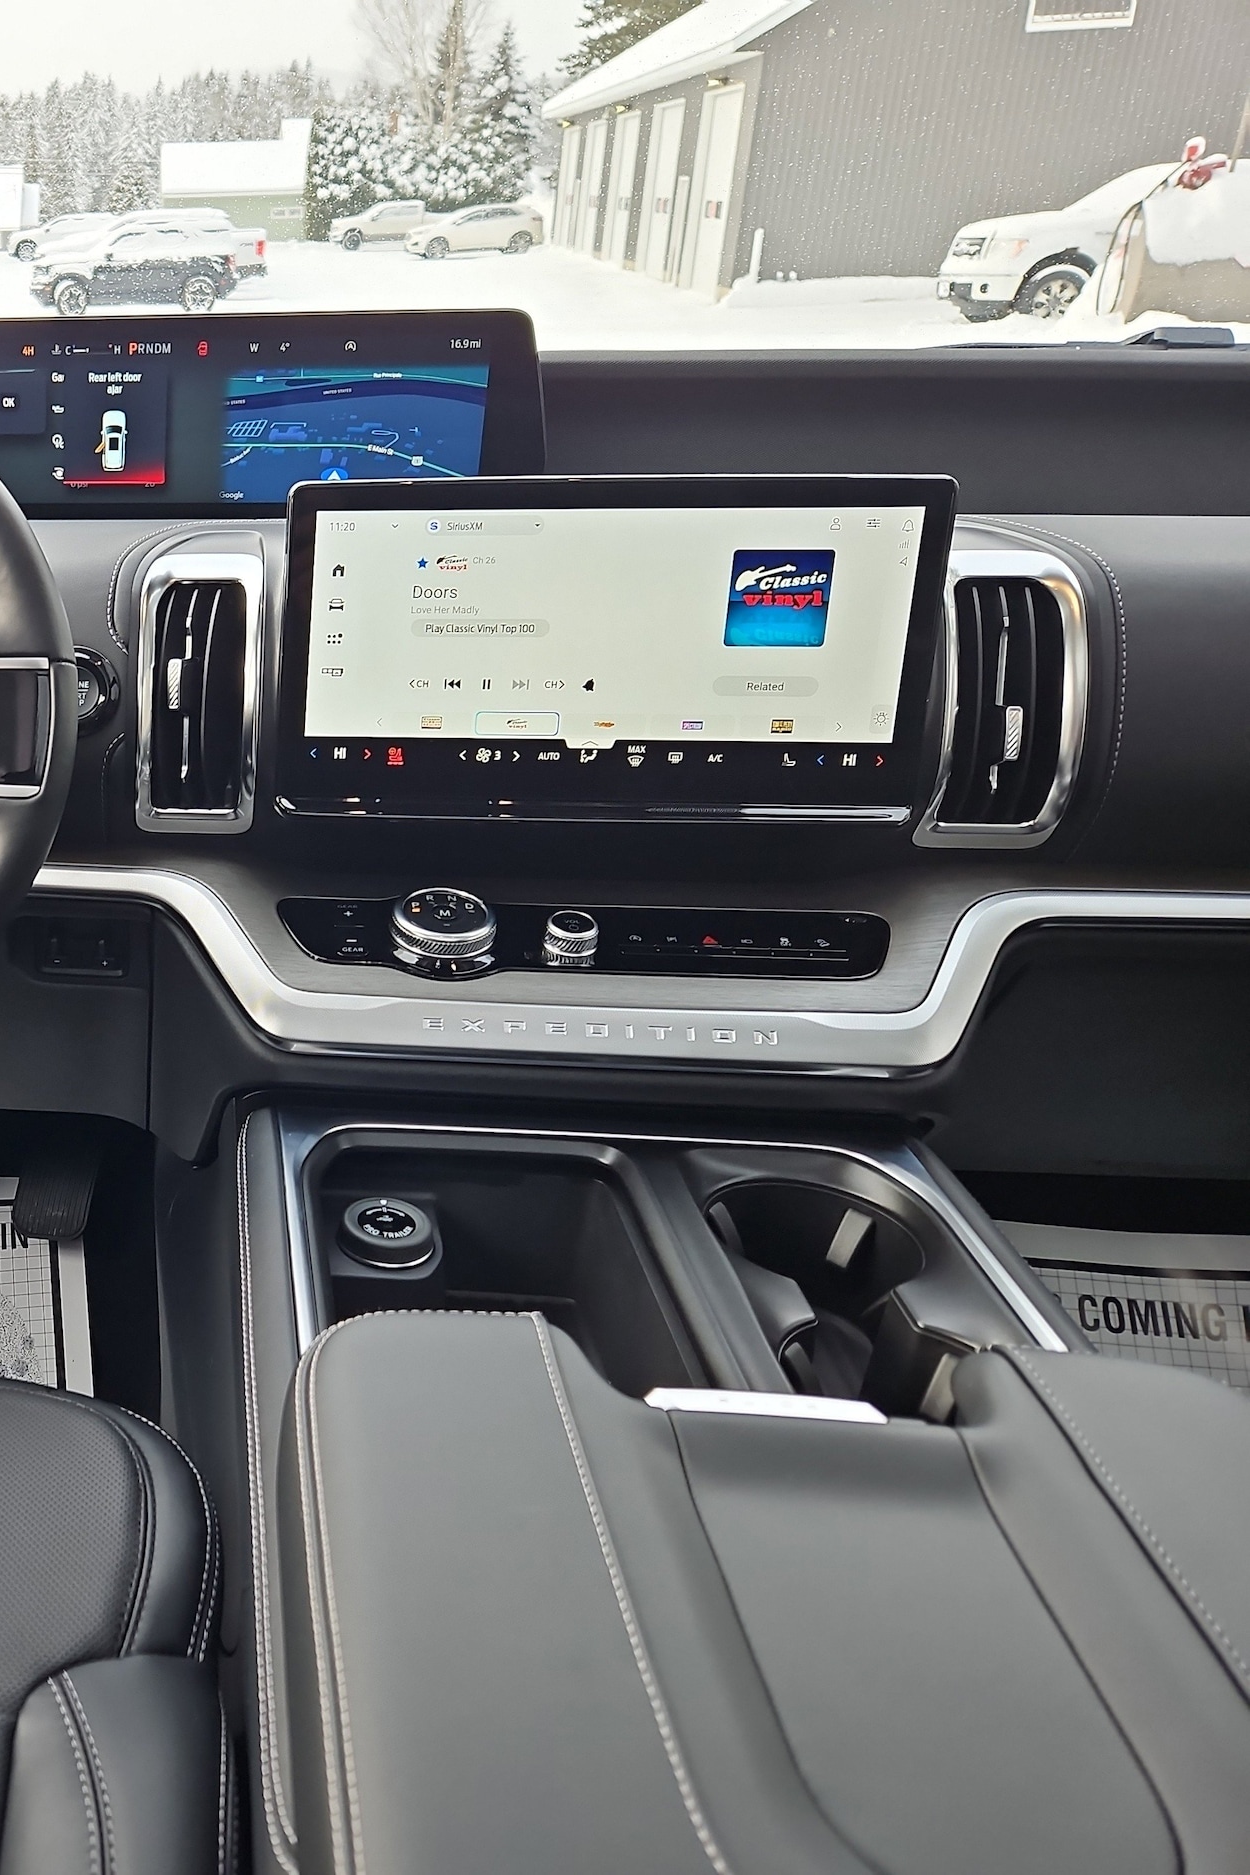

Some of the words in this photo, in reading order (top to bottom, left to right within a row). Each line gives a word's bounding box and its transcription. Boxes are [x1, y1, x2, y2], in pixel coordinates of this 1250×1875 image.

[250, 342, 259, 353] W
[280, 342, 290, 352] 4°
[450, 339, 469, 349] 16.9
[470, 339, 482, 349] mi
[22, 346, 35, 356] 4H
[65, 346, 71, 355] C
[114, 345, 121, 354] H
[89, 372, 107, 383] Rear
[108, 371, 122, 383] left
[123, 371, 142, 382] door
[106, 384, 123, 396] ajar
[2, 397, 15, 409] OK
[373, 445, 387, 454] Main
[219, 491, 244, 500] Google
[330, 522, 356, 532] 11:20
[447, 522, 483, 531] SiriusXM
[472, 556, 484, 565] Ch
[485, 556, 496, 565] 26
[759, 571, 828, 591] Classic
[412, 585, 458, 599] Doors
[743, 590, 823, 610] vinyl
[411, 606, 432, 614] Love
[433, 606, 450, 614] Her
[452, 606, 480, 616] Madly
[425, 623, 444, 634] Play
[445, 624, 474, 633] Classic
[476, 623, 499, 634] Vinyl
[500, 624, 518, 635] Top
[518, 624, 535, 634] 100
[416, 679, 429, 688] CH
[544, 680, 558, 689] CH
[746, 682, 784, 691] Related
[333, 746, 347, 760] HI
[627, 745, 646, 754] MAX
[493, 750, 501, 760] 3
[537, 751, 560, 761] AUTO
[707, 753, 723, 763] A/C
[842, 753, 857, 767] HI
[465, 902, 475, 910] D
[439, 909, 451, 917] M
[422, 1017, 779, 1046] EXPEDITION
[1078, 1294, 1228, 1342] COMING
